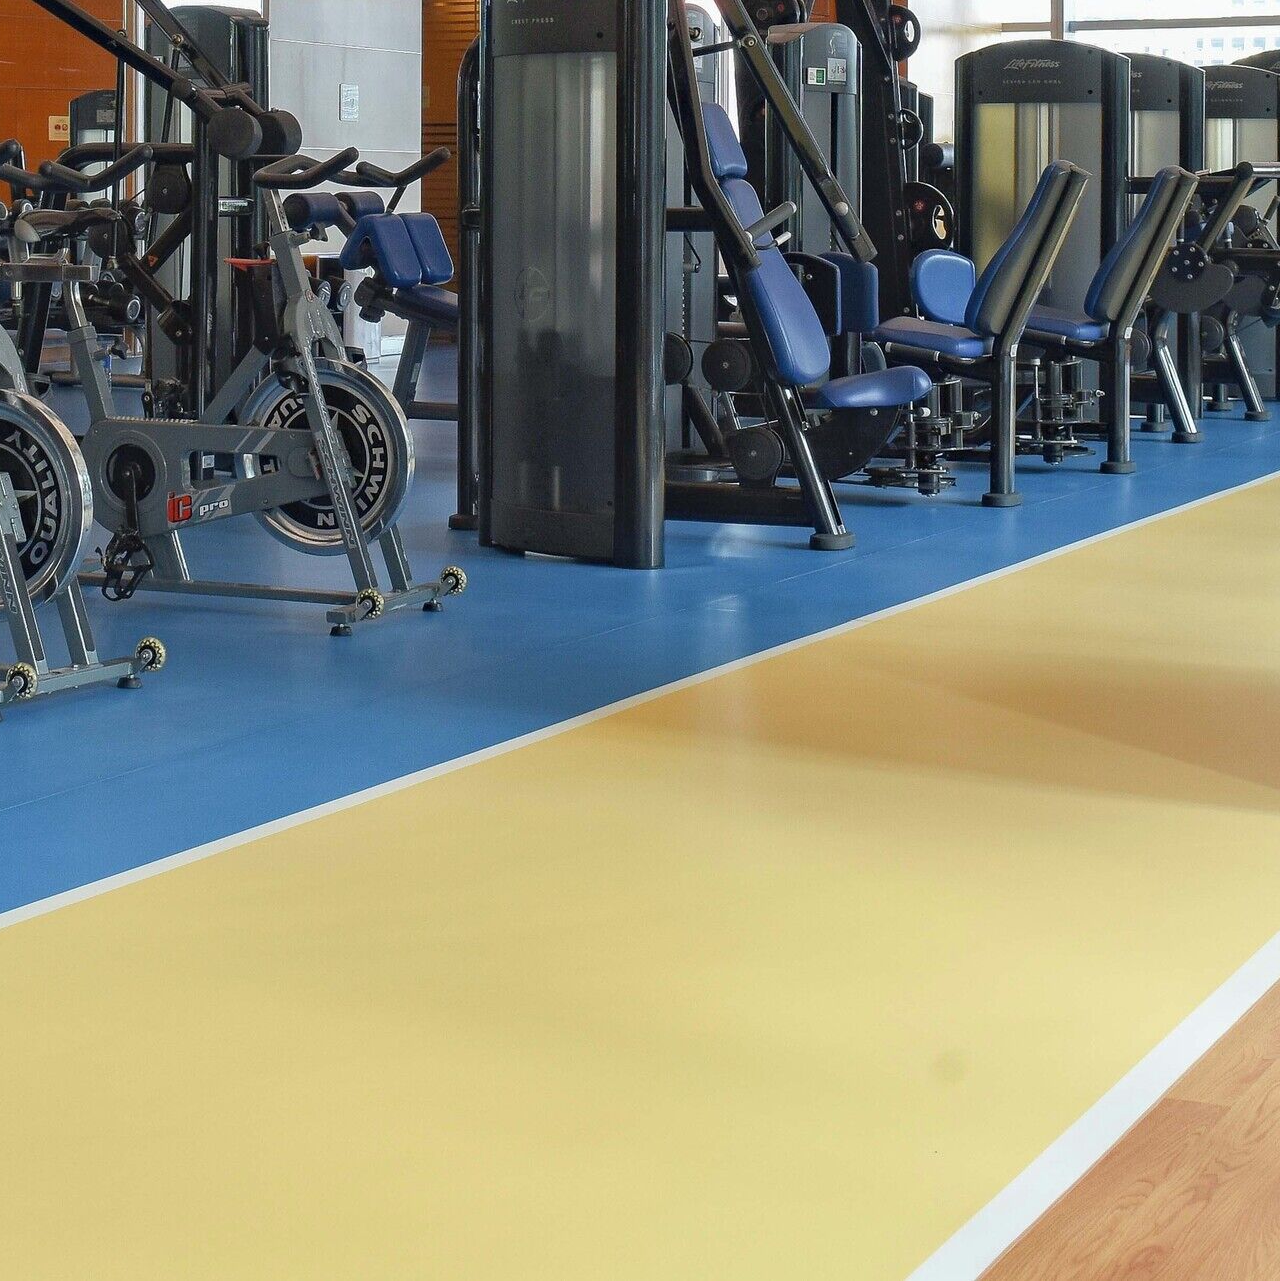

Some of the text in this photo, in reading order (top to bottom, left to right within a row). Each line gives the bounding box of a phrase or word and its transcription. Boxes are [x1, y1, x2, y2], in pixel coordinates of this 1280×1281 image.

[5, 429, 59, 565] QUALITY
[199, 499, 230, 517] pro
[317, 403, 384, 526] SCHWIN
